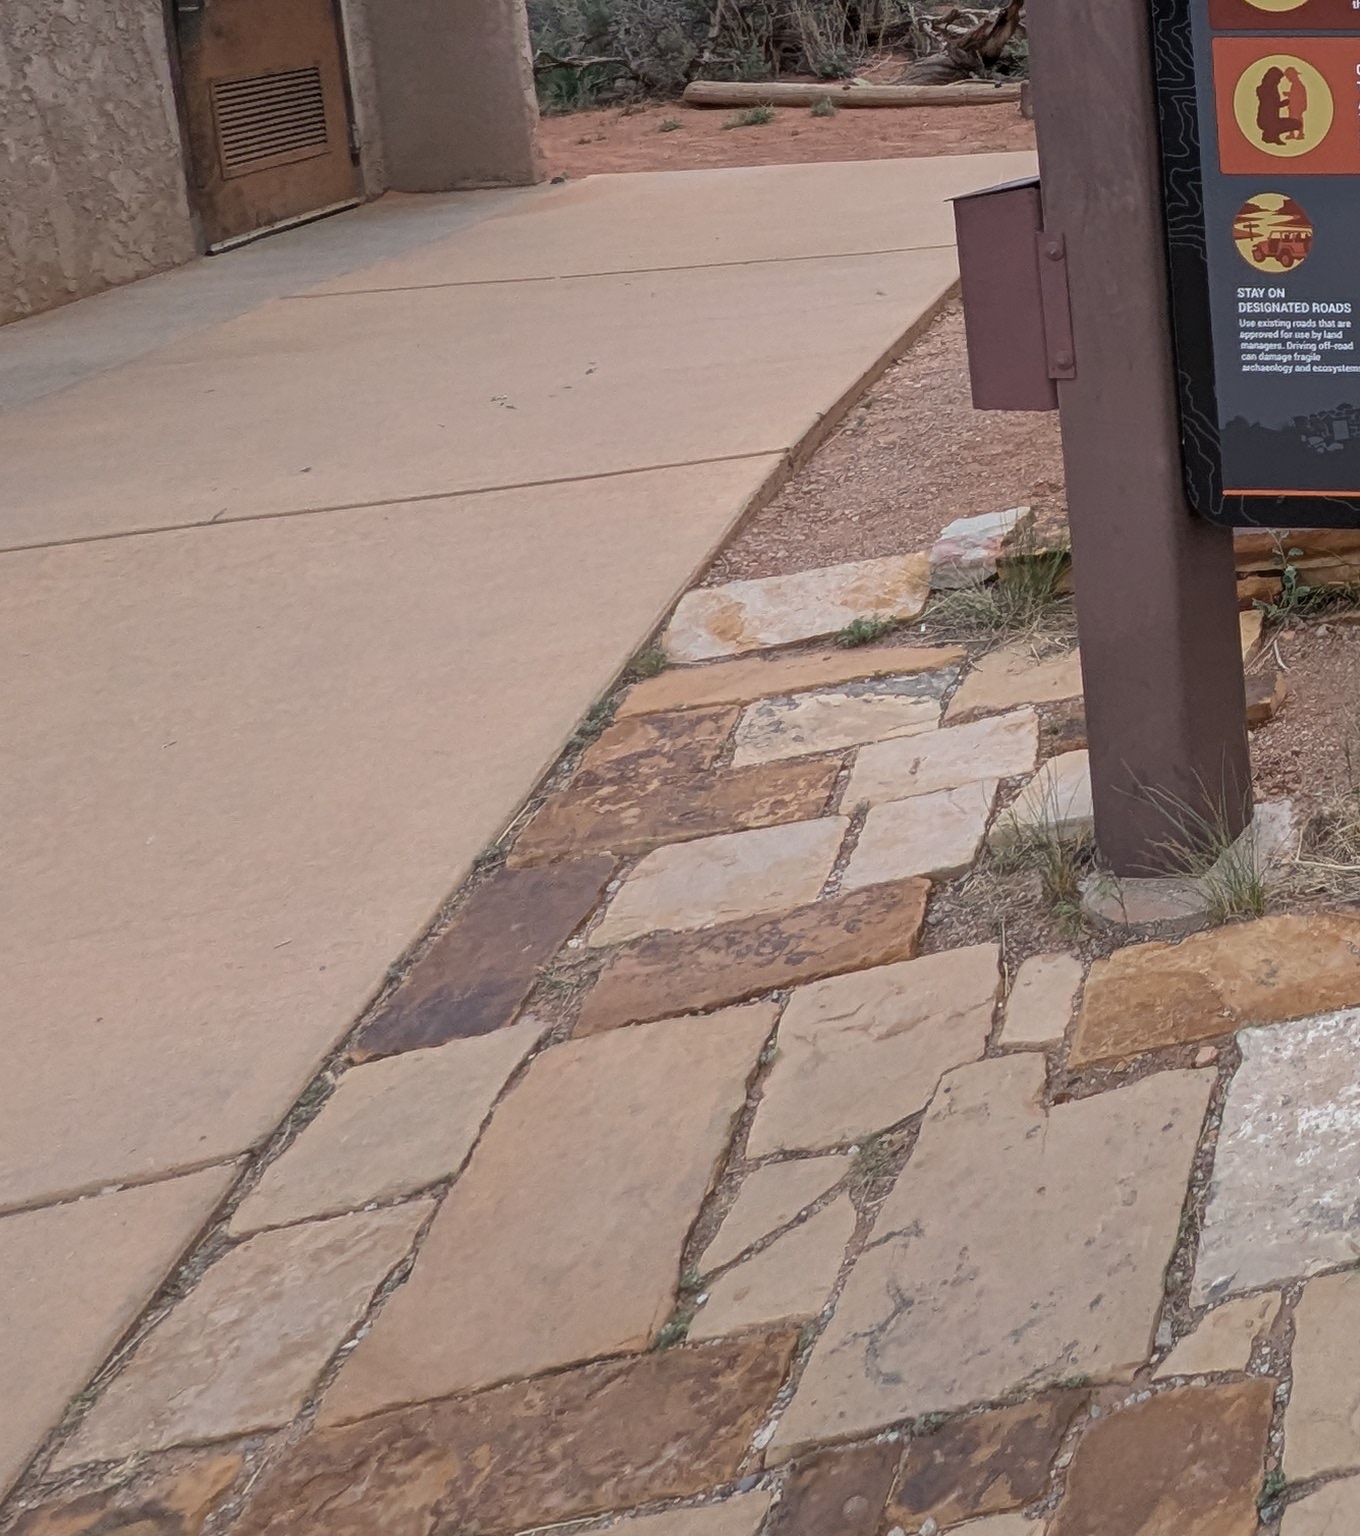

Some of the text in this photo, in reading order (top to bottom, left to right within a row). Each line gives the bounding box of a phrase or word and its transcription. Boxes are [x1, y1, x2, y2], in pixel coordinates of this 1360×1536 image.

[1237, 287, 1285, 298] STAY ON
[1238, 301, 1352, 313] DESIGNATED ROADS
